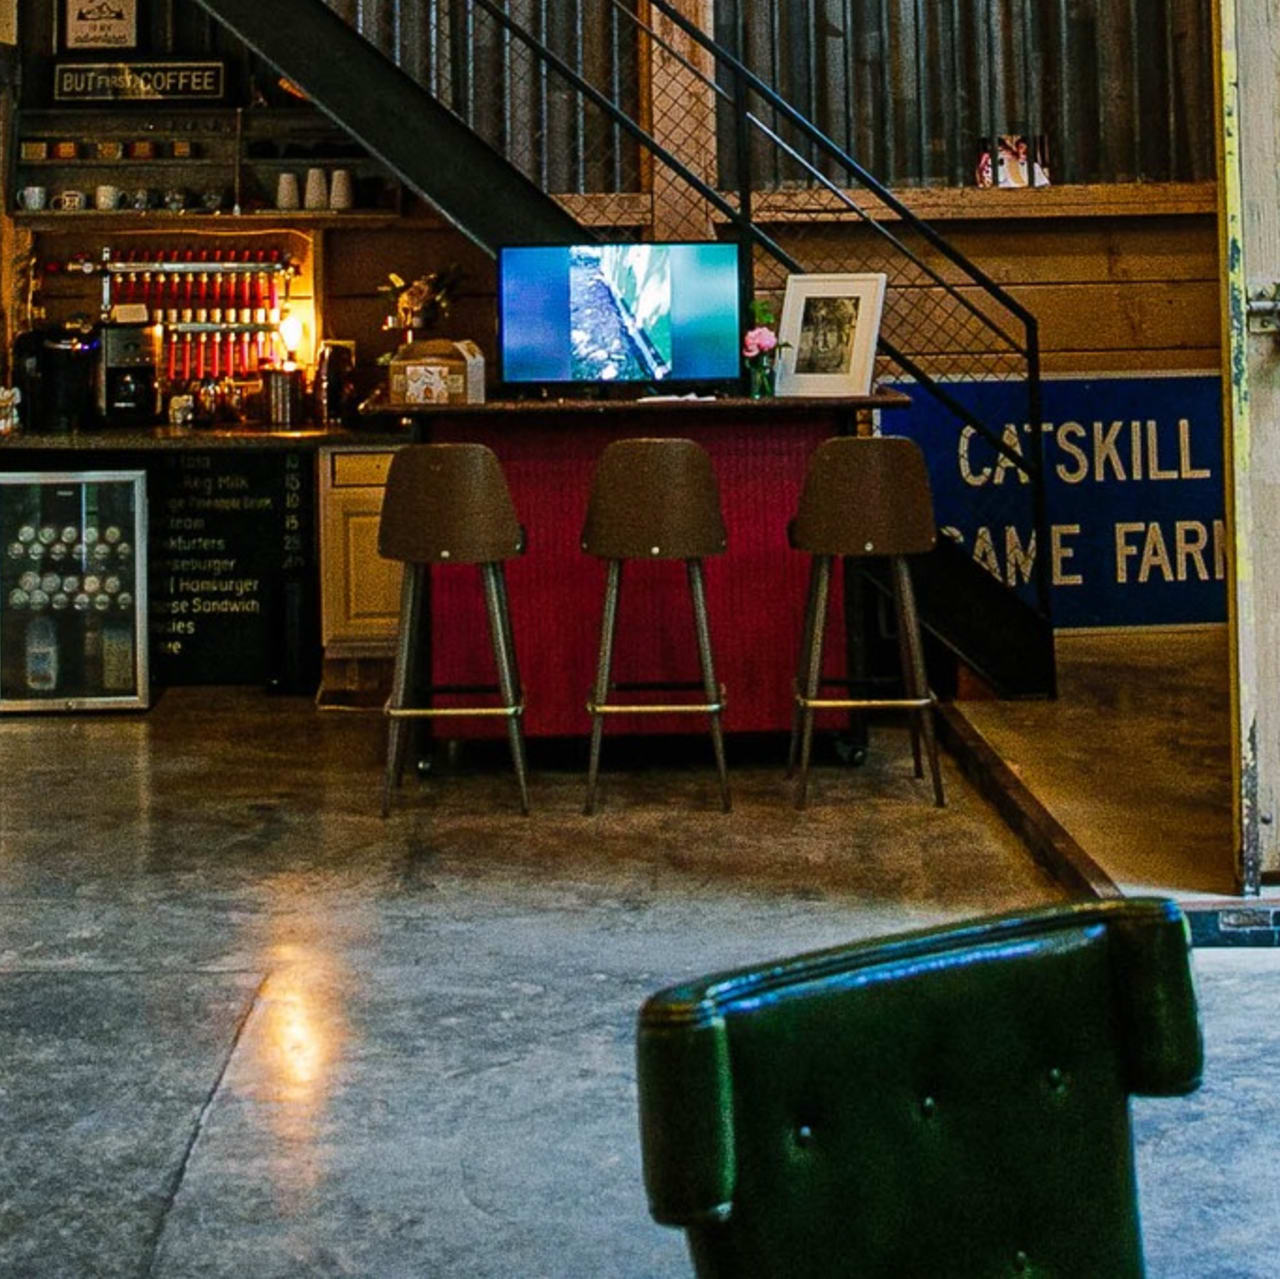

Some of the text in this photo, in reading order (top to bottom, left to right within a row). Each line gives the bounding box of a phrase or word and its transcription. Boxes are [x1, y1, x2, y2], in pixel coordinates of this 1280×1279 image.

[63, 71, 96, 92] BUT
[140, 70, 215, 91] COFFEE
[939, 523, 1084, 588] AME
[179, 577, 261, 597] Hamburger
[191, 596, 262, 615] Sandwich
